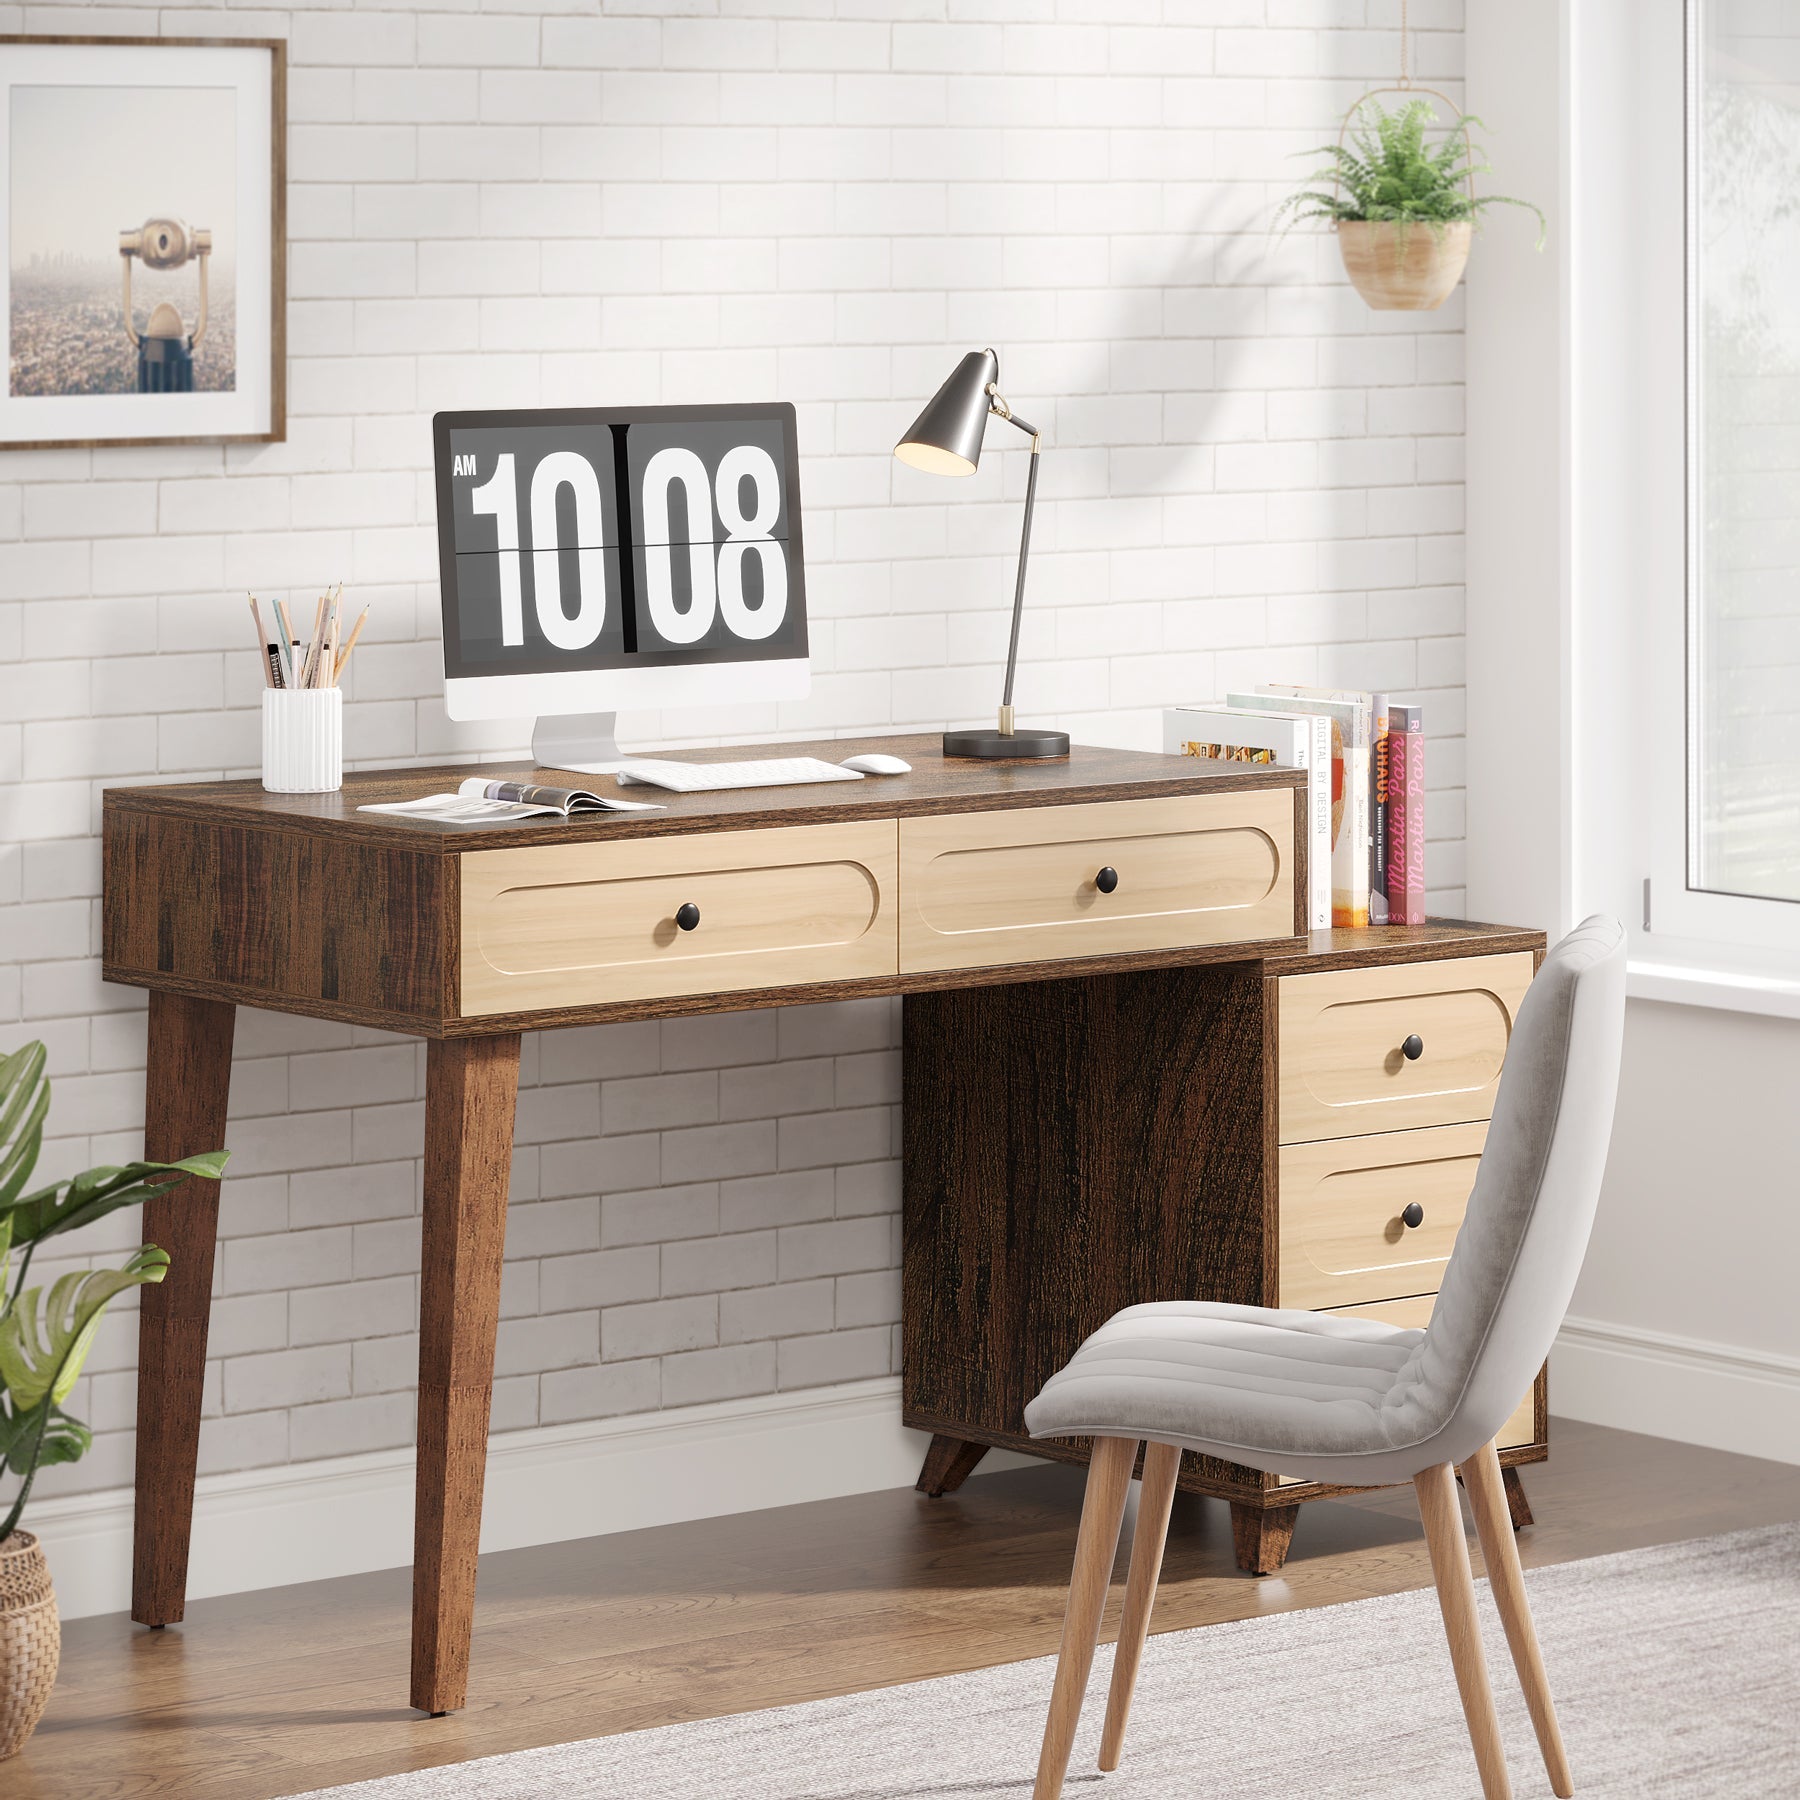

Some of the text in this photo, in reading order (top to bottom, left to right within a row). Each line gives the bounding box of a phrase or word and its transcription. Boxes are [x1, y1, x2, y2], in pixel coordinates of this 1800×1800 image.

[453, 454, 477, 477] AM
[472, 451, 606, 650] 10
[643, 445, 788, 644] 08
[1317, 718, 1327, 765] DIGITAL
[1376, 717, 1388, 803] BAUHAUS
[1389, 735, 1405, 798] Parr
[1408, 735, 1424, 798] Parr
[1317, 771, 1327, 784] BY
[1317, 792, 1327, 835] DESIGN
[1389, 803, 1406, 890] Martin
[1408, 802, 1424, 889] Martin
